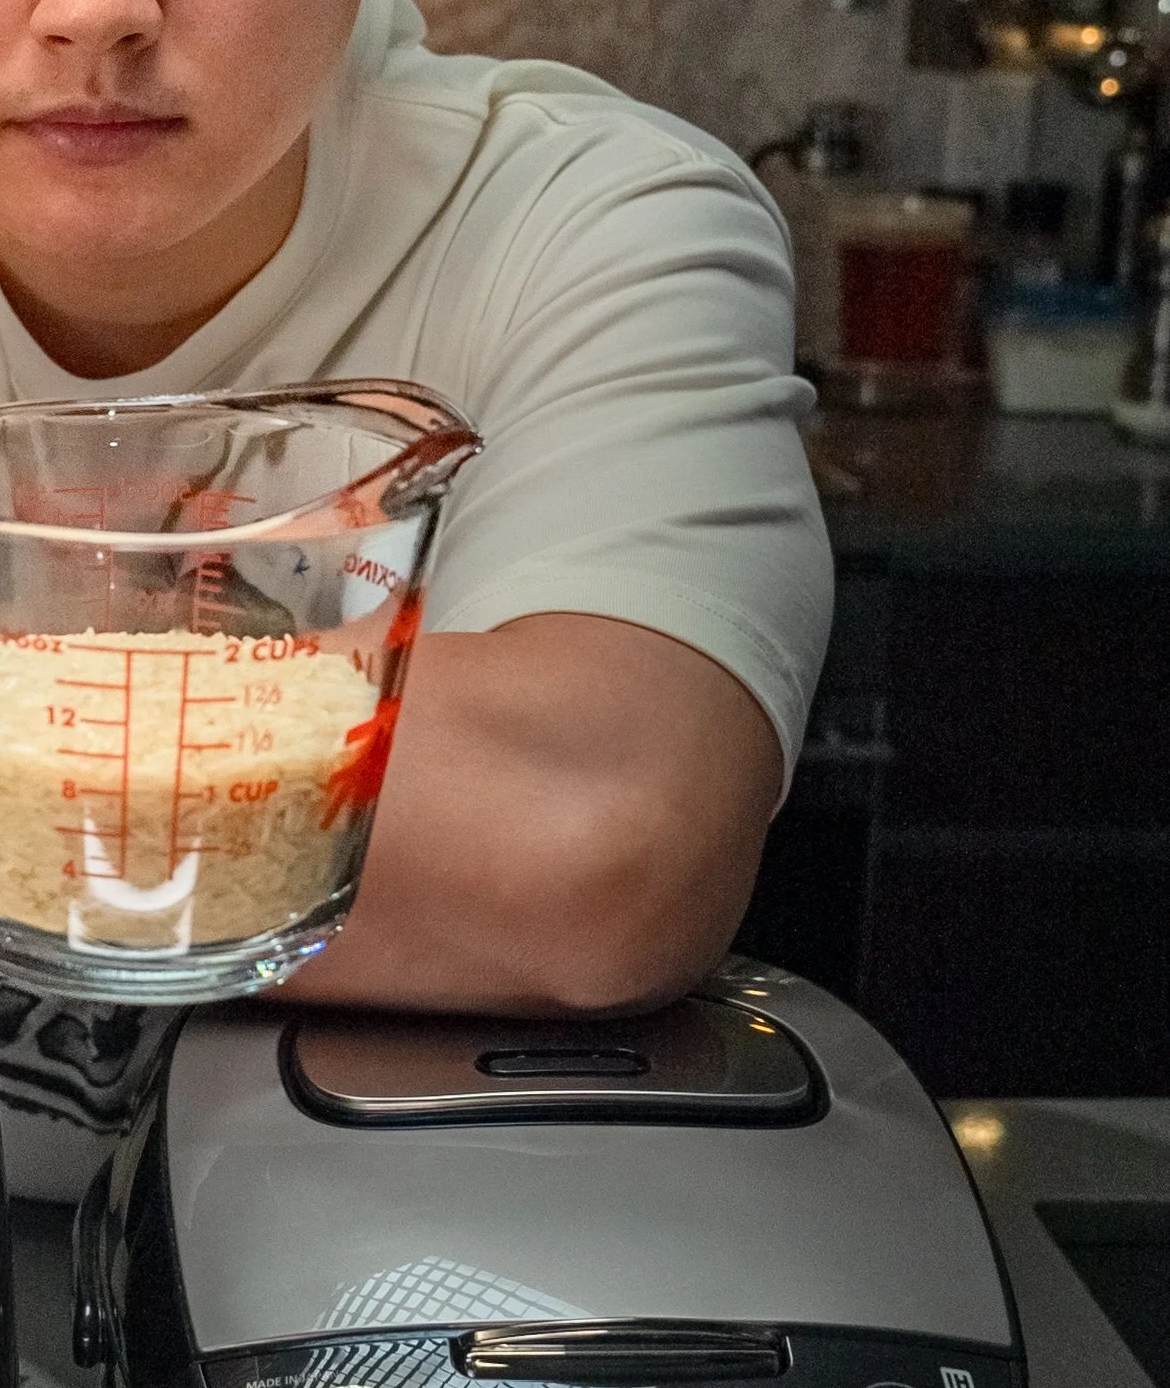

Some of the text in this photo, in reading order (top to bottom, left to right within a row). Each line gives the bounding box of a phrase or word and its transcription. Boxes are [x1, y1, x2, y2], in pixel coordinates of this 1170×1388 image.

[225, 636, 321, 663] 2 CUPS
[46, 706, 76, 727] 12
[62, 781, 76, 799] 8
[229, 780, 278, 803] CUP
[62, 862, 76, 878] 4
